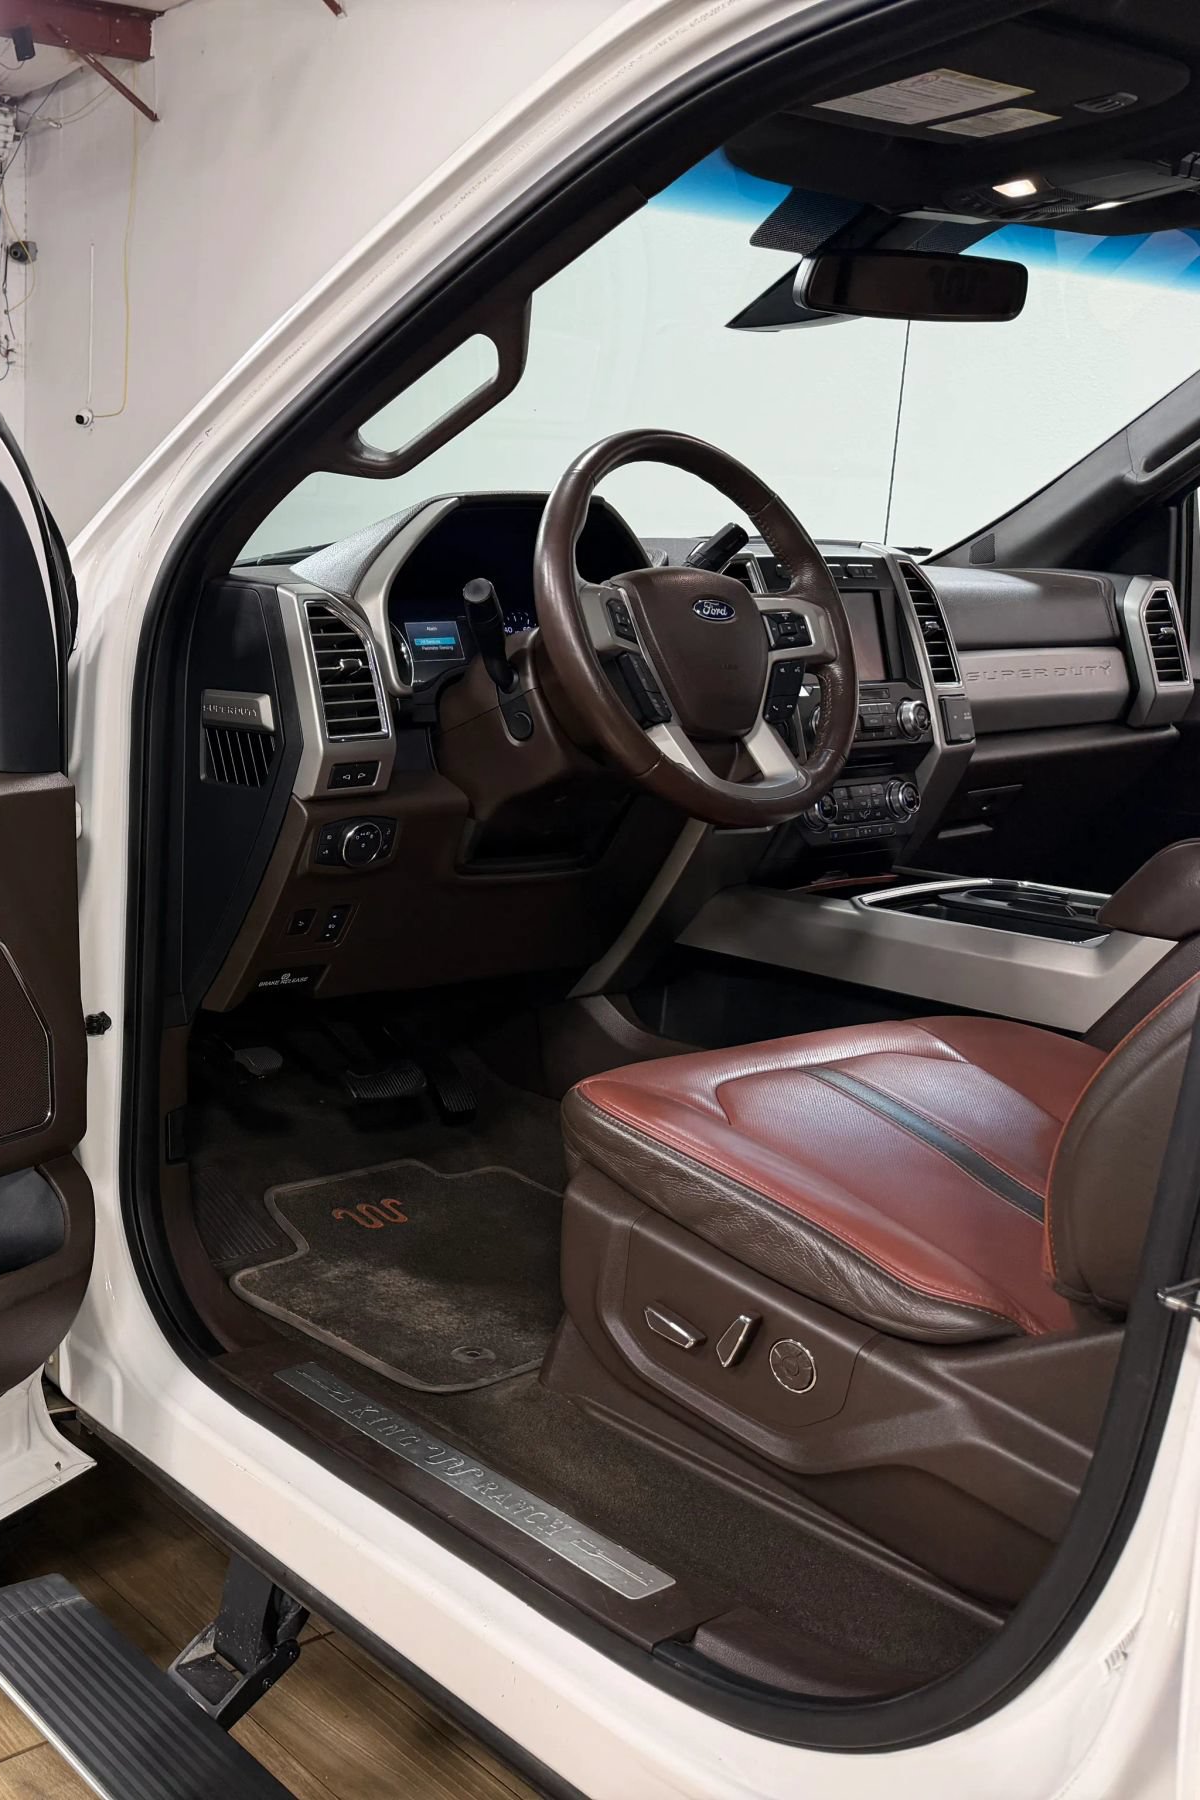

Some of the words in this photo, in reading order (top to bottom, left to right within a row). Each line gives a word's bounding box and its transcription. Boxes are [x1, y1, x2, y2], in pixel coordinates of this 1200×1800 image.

[702, 602, 728, 617] Ford
[965, 668, 1049, 682] SUPER
[1054, 663, 1112, 677] DUTY
[258, 979, 280, 987] BRAKE
[280, 976, 309, 984] RELEASE
[349, 1405, 421, 1447] KING
[472, 1481, 573, 1537] RANCH
